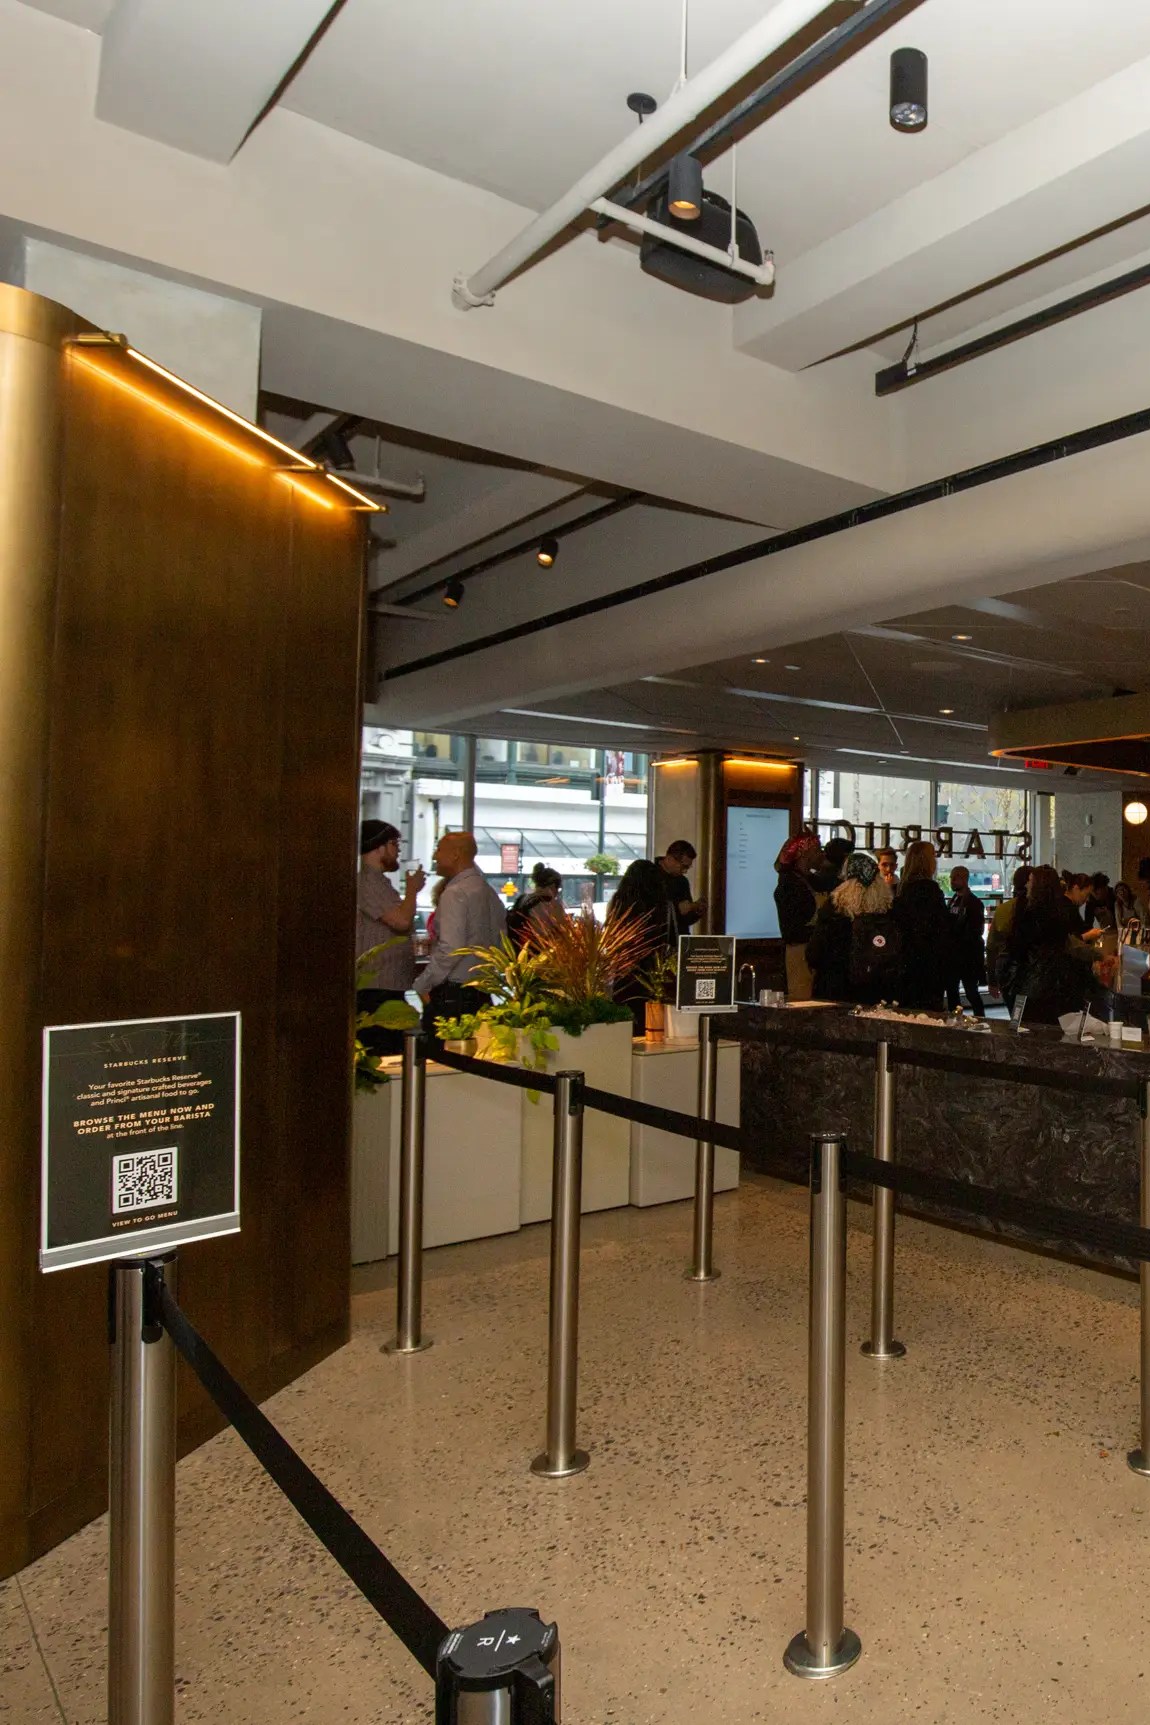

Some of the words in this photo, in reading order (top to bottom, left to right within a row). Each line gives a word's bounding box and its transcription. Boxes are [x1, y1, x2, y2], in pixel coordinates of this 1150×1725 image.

[104, 1060, 148, 1068] STARBUCKS
[108, 1081, 135, 1089] favorite
[137, 1076, 170, 1085] Starbucks
[117, 1086, 150, 1096] signature
[151, 1082, 176, 1090] crafted
[178, 1080, 212, 1088] beverages
[131, 1093, 160, 1101] artisanal
[74, 1116, 114, 1127] BROWSE
[140, 1110, 166, 1118] MENU
[171, 1106, 192, 1114] NOW
[195, 1103, 214, 1111] AND
[78, 1125, 110, 1134] ORDER
[115, 1121, 141, 1130] FROM
[145, 1116, 170, 1125] YOUR
[174, 1112, 211, 1121] BARISTA
[158, 1211, 178, 1219] MENU
